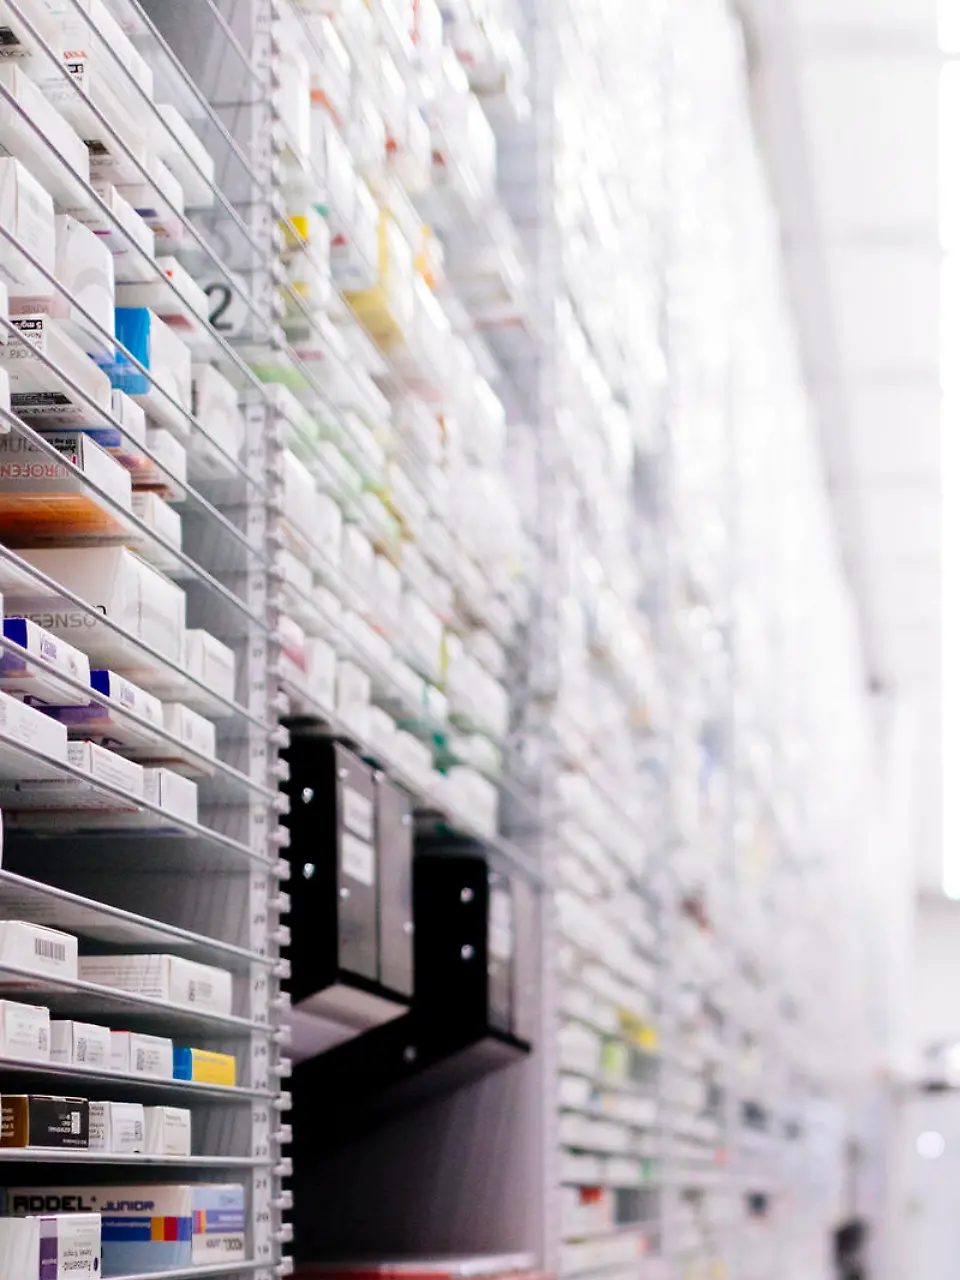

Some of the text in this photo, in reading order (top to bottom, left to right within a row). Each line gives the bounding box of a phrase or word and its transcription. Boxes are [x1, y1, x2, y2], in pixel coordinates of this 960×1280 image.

[204, 282, 232, 331] 2
[255, 1180, 268, 1188] 21
[13, 1195, 155, 1212] ADDEL JUNIOR
[256, 1213, 269, 1222] 20
